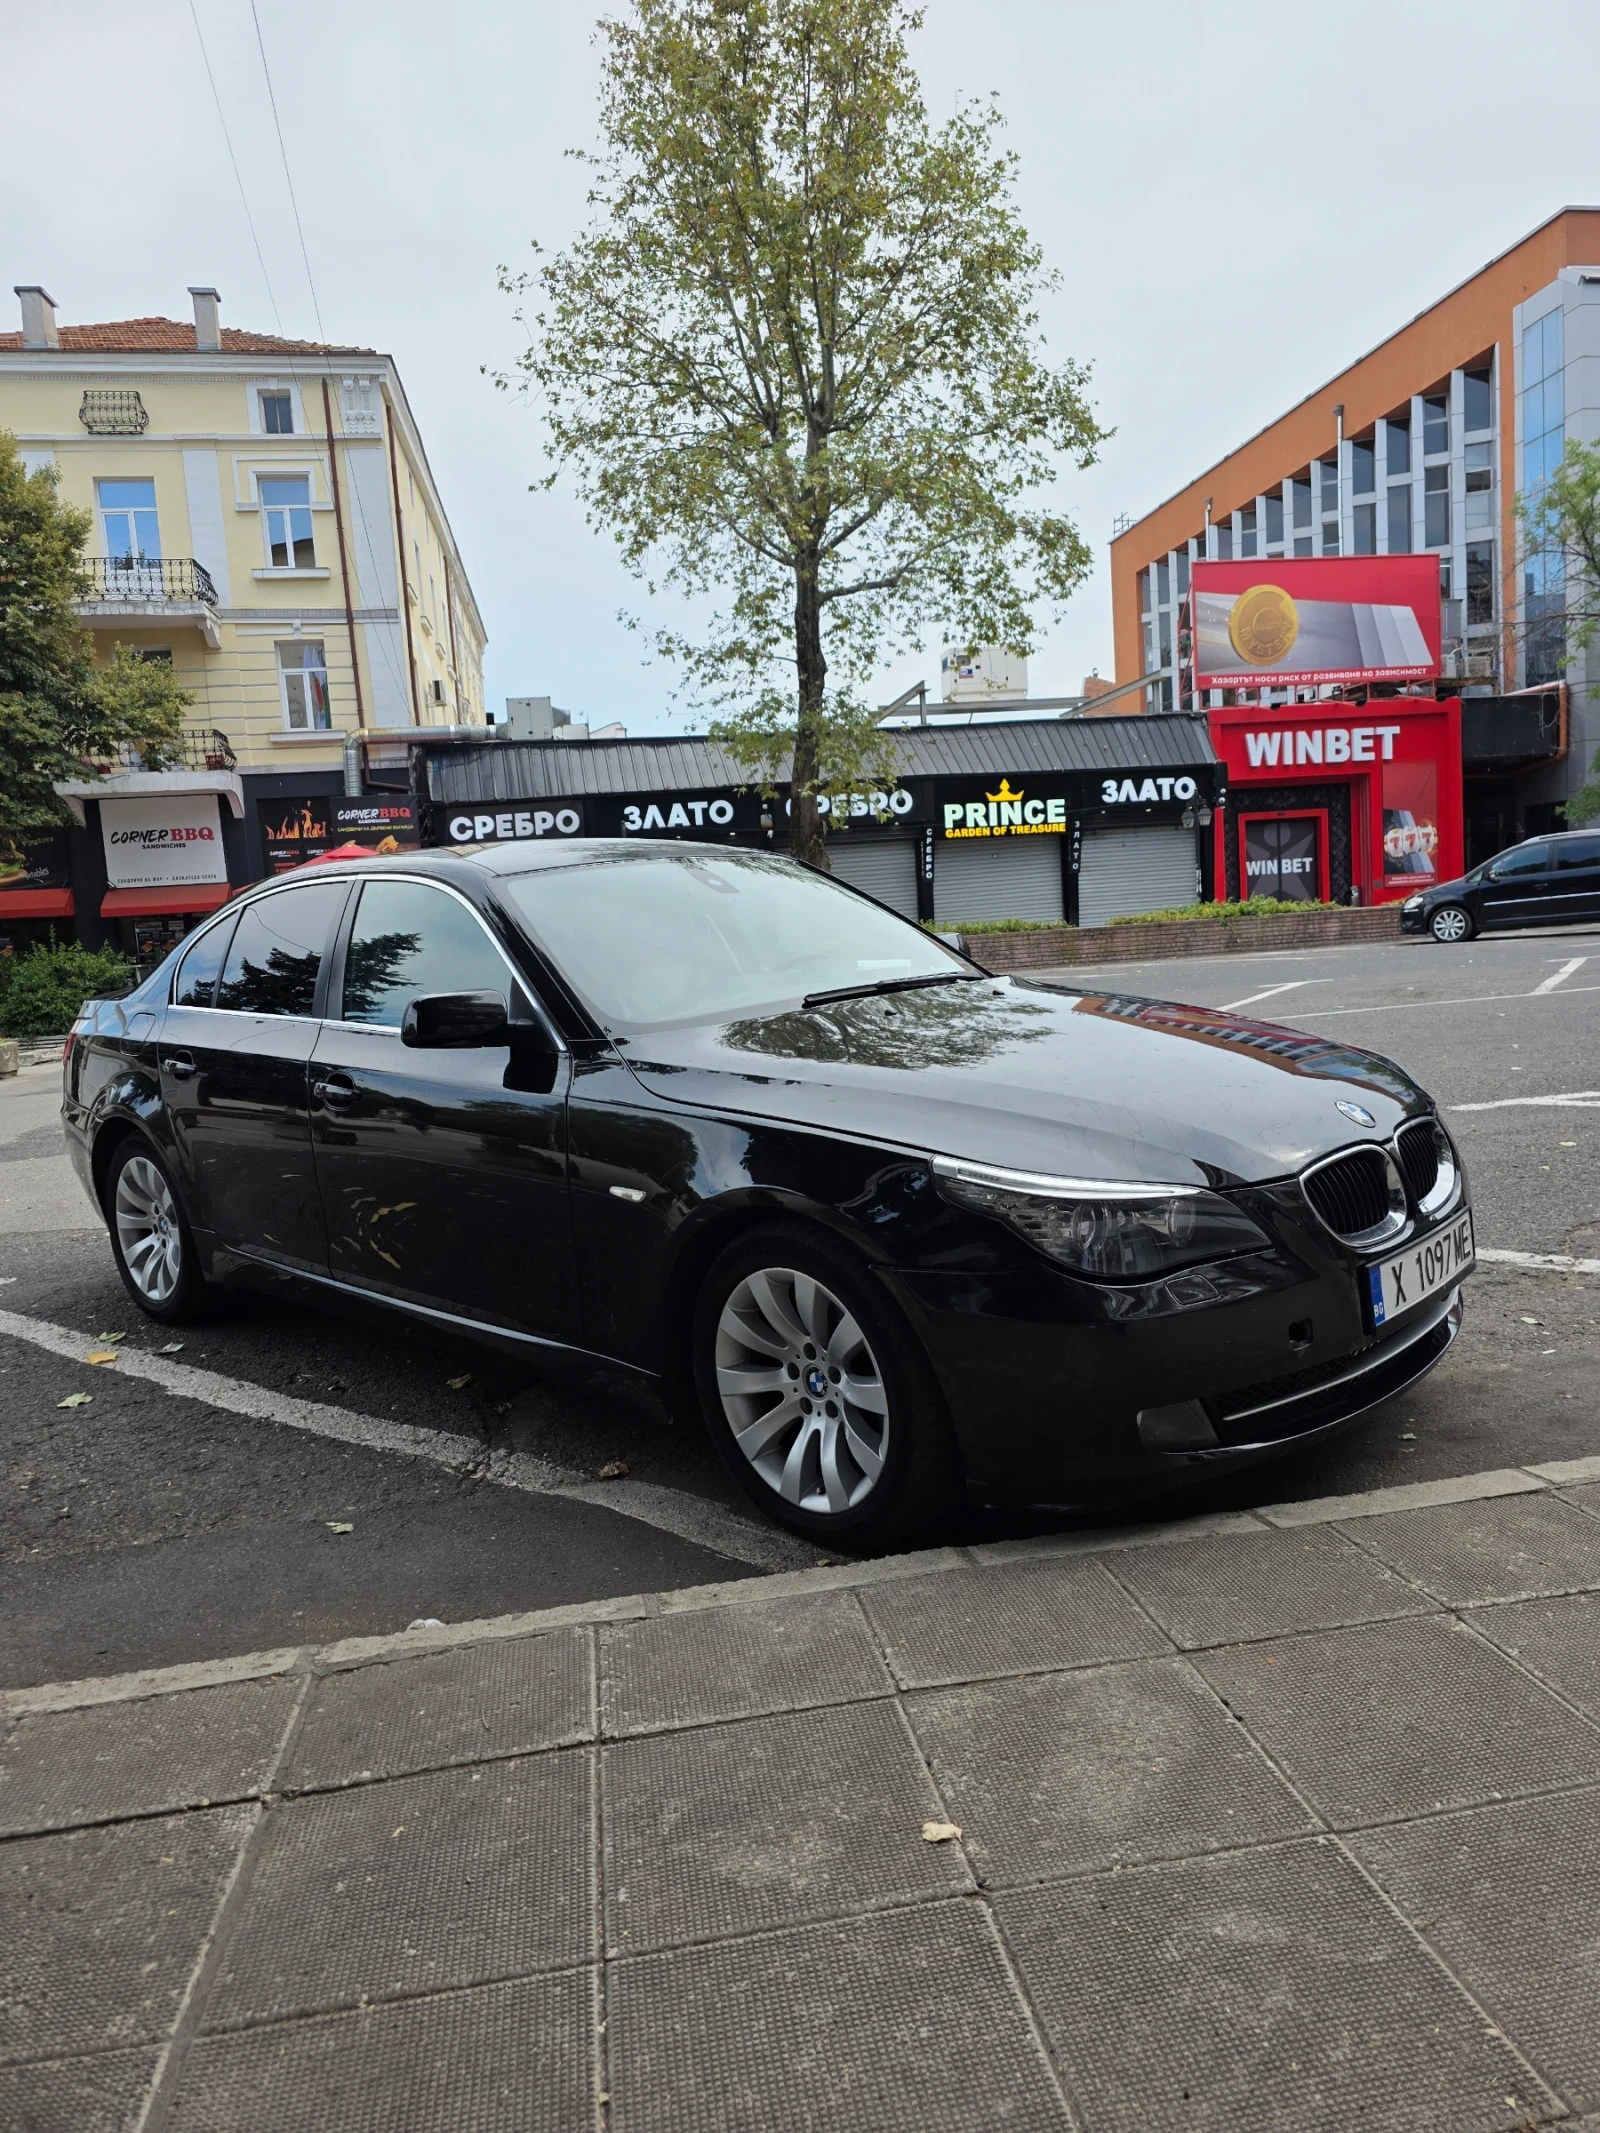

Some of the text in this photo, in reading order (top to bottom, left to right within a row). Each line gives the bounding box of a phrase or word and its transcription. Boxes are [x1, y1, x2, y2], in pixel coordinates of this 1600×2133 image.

[1211, 676, 1253, 685] Хазартът
[1254, 675, 1278, 683] носи
[1278, 674, 1299, 683] риск
[1313, 671, 1360, 681] развиване
[1362, 670, 1373, 678] на
[1374, 667, 1427, 677] зависимост
[1245, 726, 1400, 767] WINBET
[785, 789, 913, 817] РЕБРО
[1101, 776, 1197, 803] ЗЛАТО
[337, 807, 411, 820] CORNER BBQ
[449, 809, 580, 841] СРЕБРО
[623, 799, 734, 831] ЗЛАТО
[944, 798, 1067, 828] PRINCE
[110, 826, 215, 845] CORNER BBQ
[945, 823, 1067, 838] GARDEN OF TREASURE
[141, 842, 187, 850] SANDWICHES
[925, 828, 933, 879] СРЕБРО
[1072, 820, 1080, 870] ЗЛАТО
[1246, 857, 1313, 876] WINBET
[1391, 1261, 1407, 1308] X
[1415, 1232, 1451, 1292] 1097
[1373, 1301, 1384, 1318] BG
